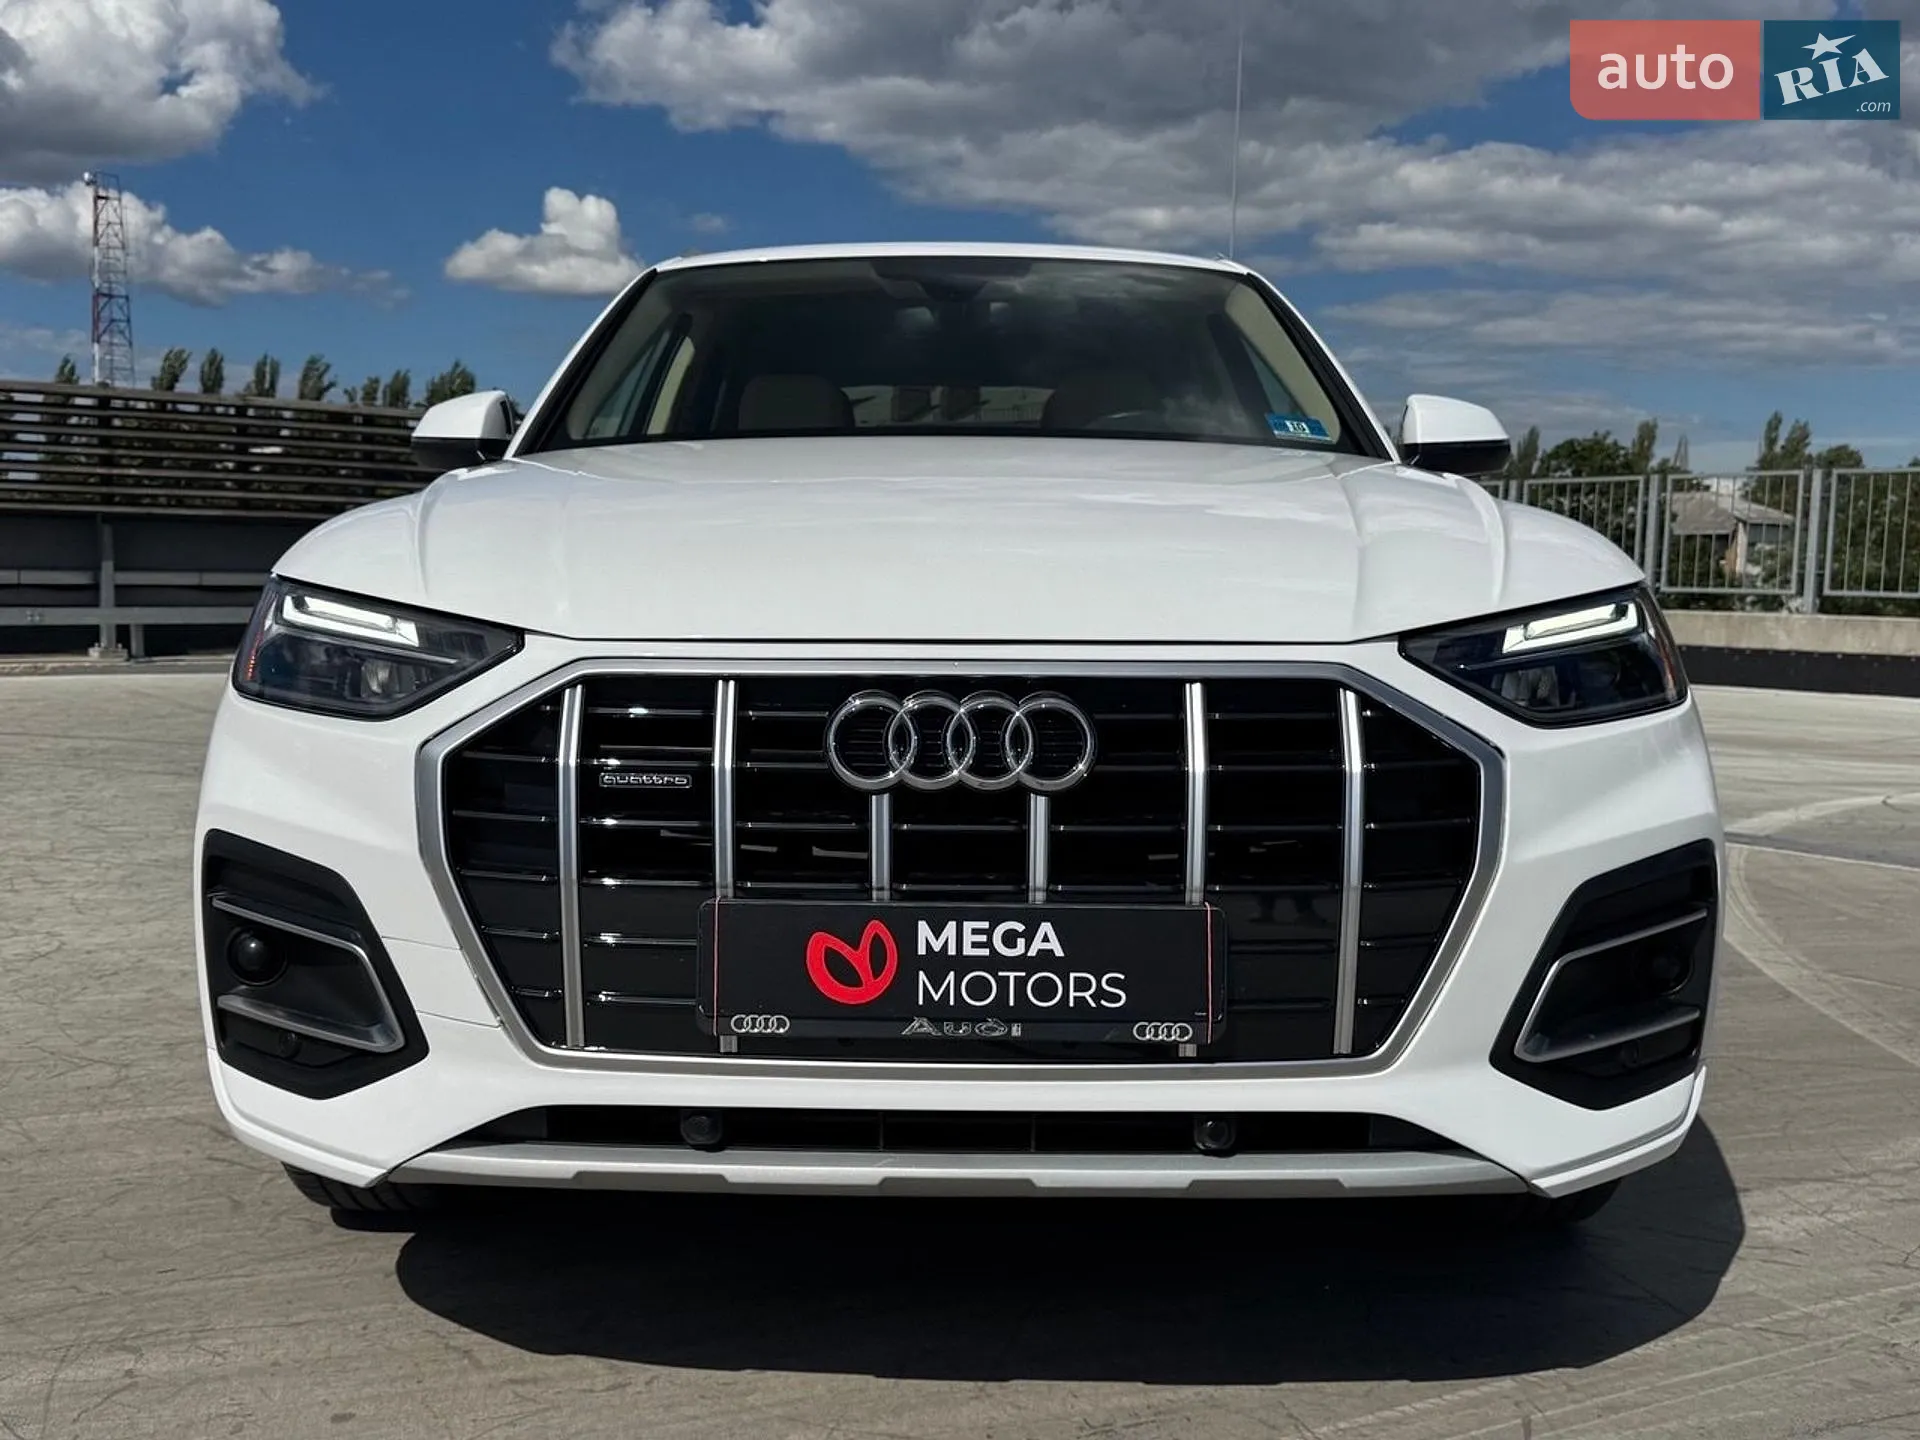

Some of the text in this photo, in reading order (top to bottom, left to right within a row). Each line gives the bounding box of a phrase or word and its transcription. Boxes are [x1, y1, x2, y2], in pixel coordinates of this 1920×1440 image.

[603, 774, 689, 785] quattro
[917, 920, 1065, 957] MEGA
[917, 970, 1127, 1008] MOTORS
